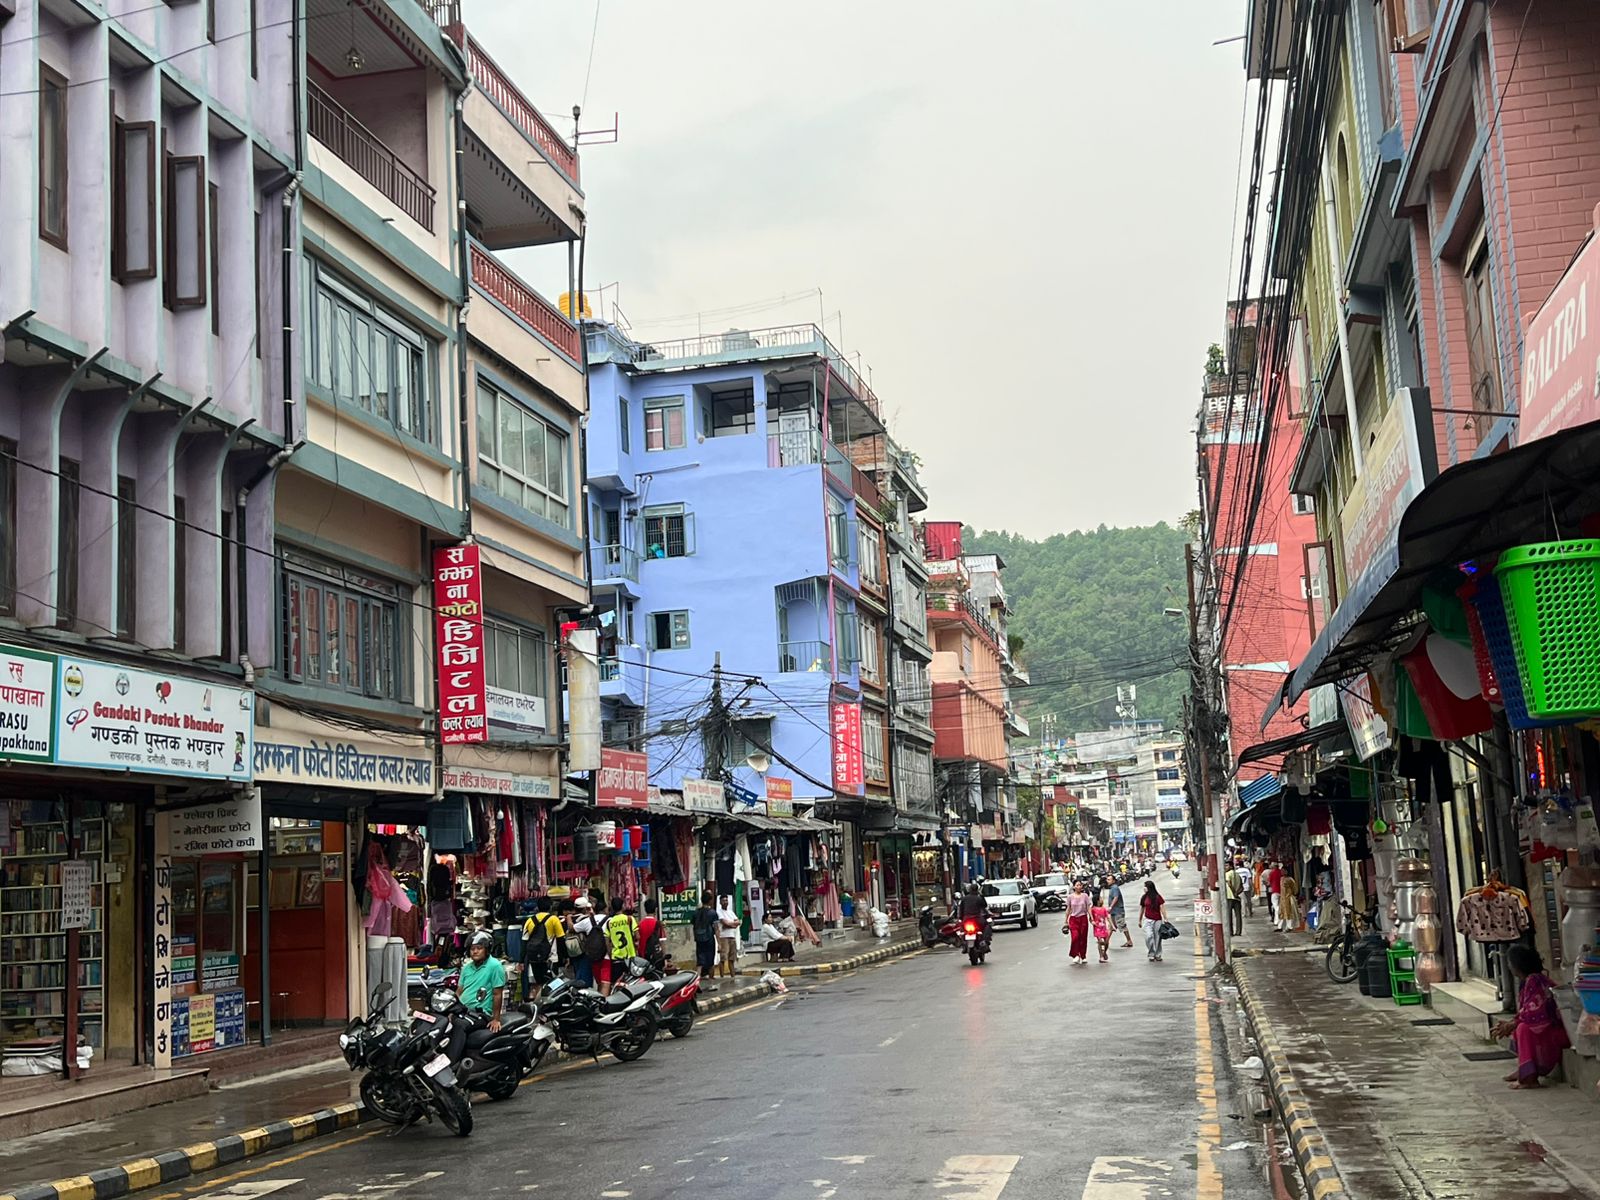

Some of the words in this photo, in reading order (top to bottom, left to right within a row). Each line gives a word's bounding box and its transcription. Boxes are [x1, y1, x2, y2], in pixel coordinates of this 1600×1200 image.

[1524, 279, 1587, 409] BALTRA
[8, 662, 24, 683] रसु
[93, 701, 141, 722] Gandaki
[145, 708, 181, 729] Pustak
[183, 714, 224, 734] Bhandar
[0, 733, 48, 752] pakhana
[91, 725, 139, 746] गण्डकी
[144, 732, 182, 754] पुस्तक
[186, 738, 225, 759] भण्डार
[303, 740, 334, 779] फोटो
[335, 743, 377, 783] डिजिटल
[378, 755, 404, 785] कलर
[405, 758, 432, 786] ल्याब
[228, 821, 251, 833] फोटो
[211, 837, 234, 850] फोटो
[236, 836, 256, 848] कपी
[615, 931, 628, 949] 3
